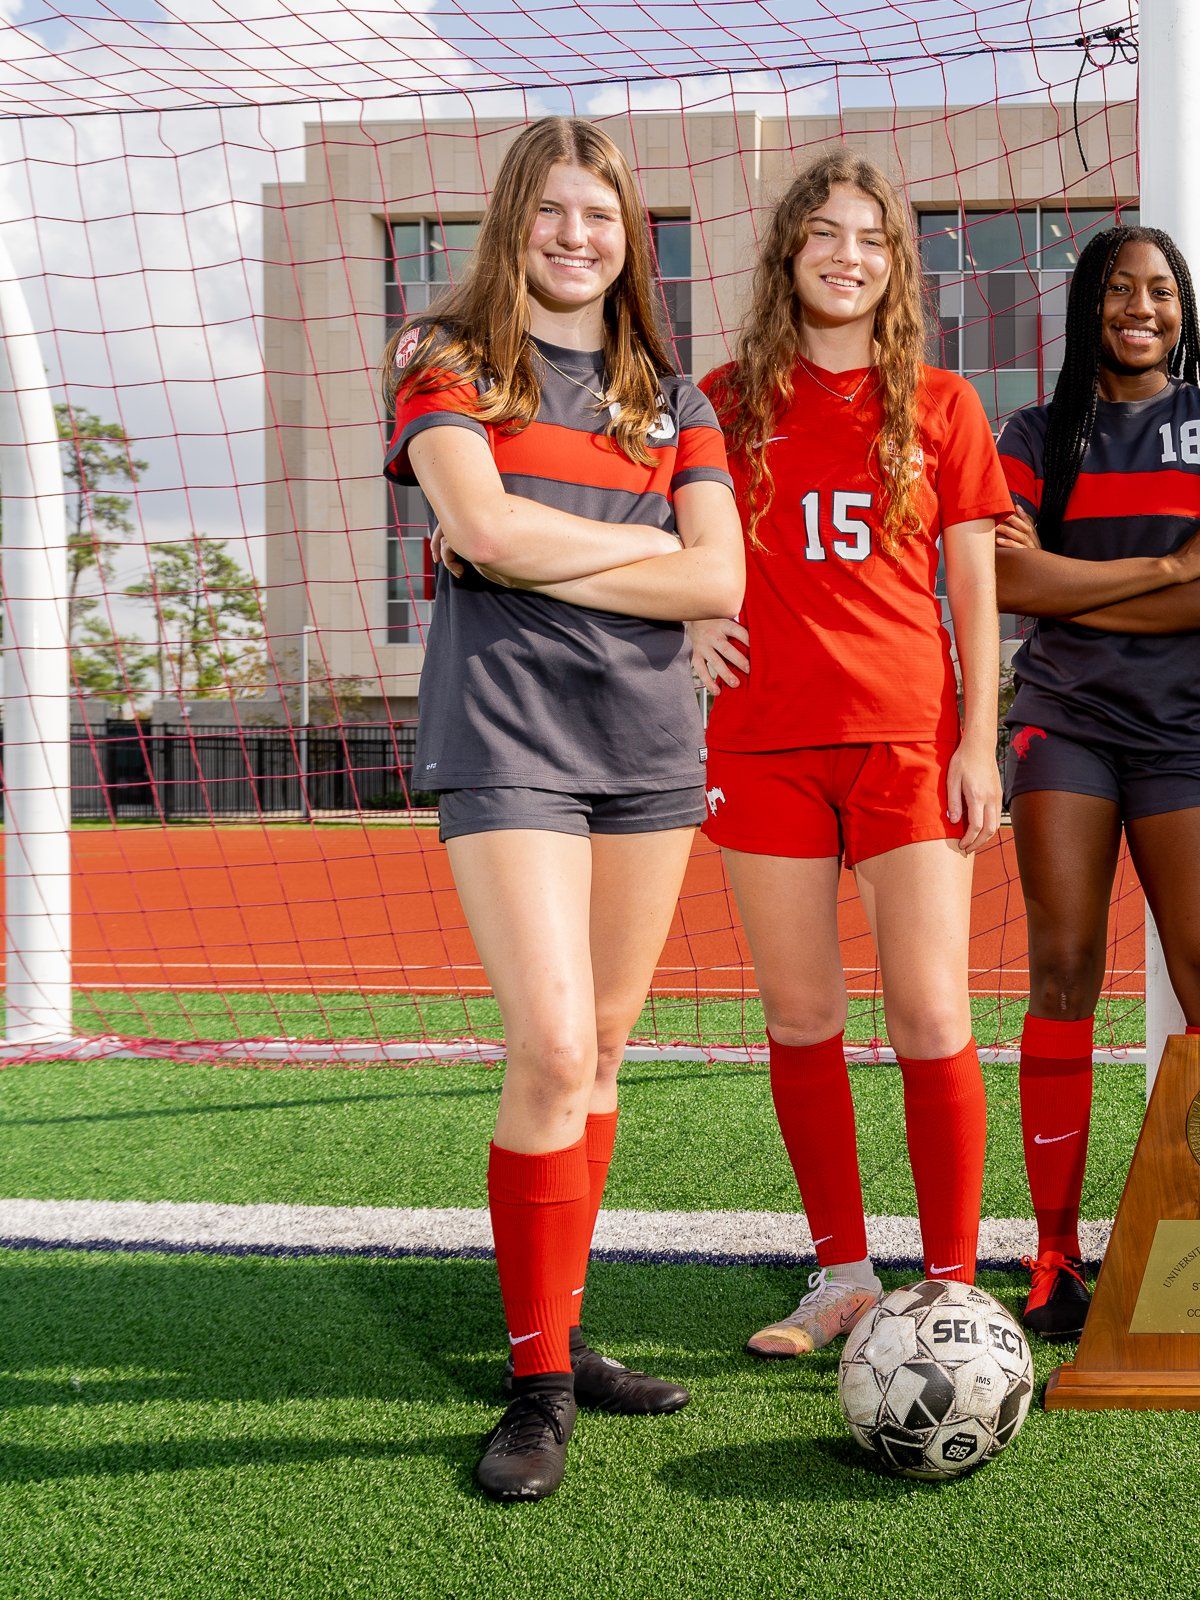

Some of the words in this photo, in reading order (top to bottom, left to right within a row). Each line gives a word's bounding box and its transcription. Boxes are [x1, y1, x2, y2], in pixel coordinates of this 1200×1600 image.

[801, 490, 873, 562] 15
[966, 1296, 991, 1307] SELECT
[933, 1319, 1024, 1360] SELECT
[975, 1375, 991, 1386] IMS
